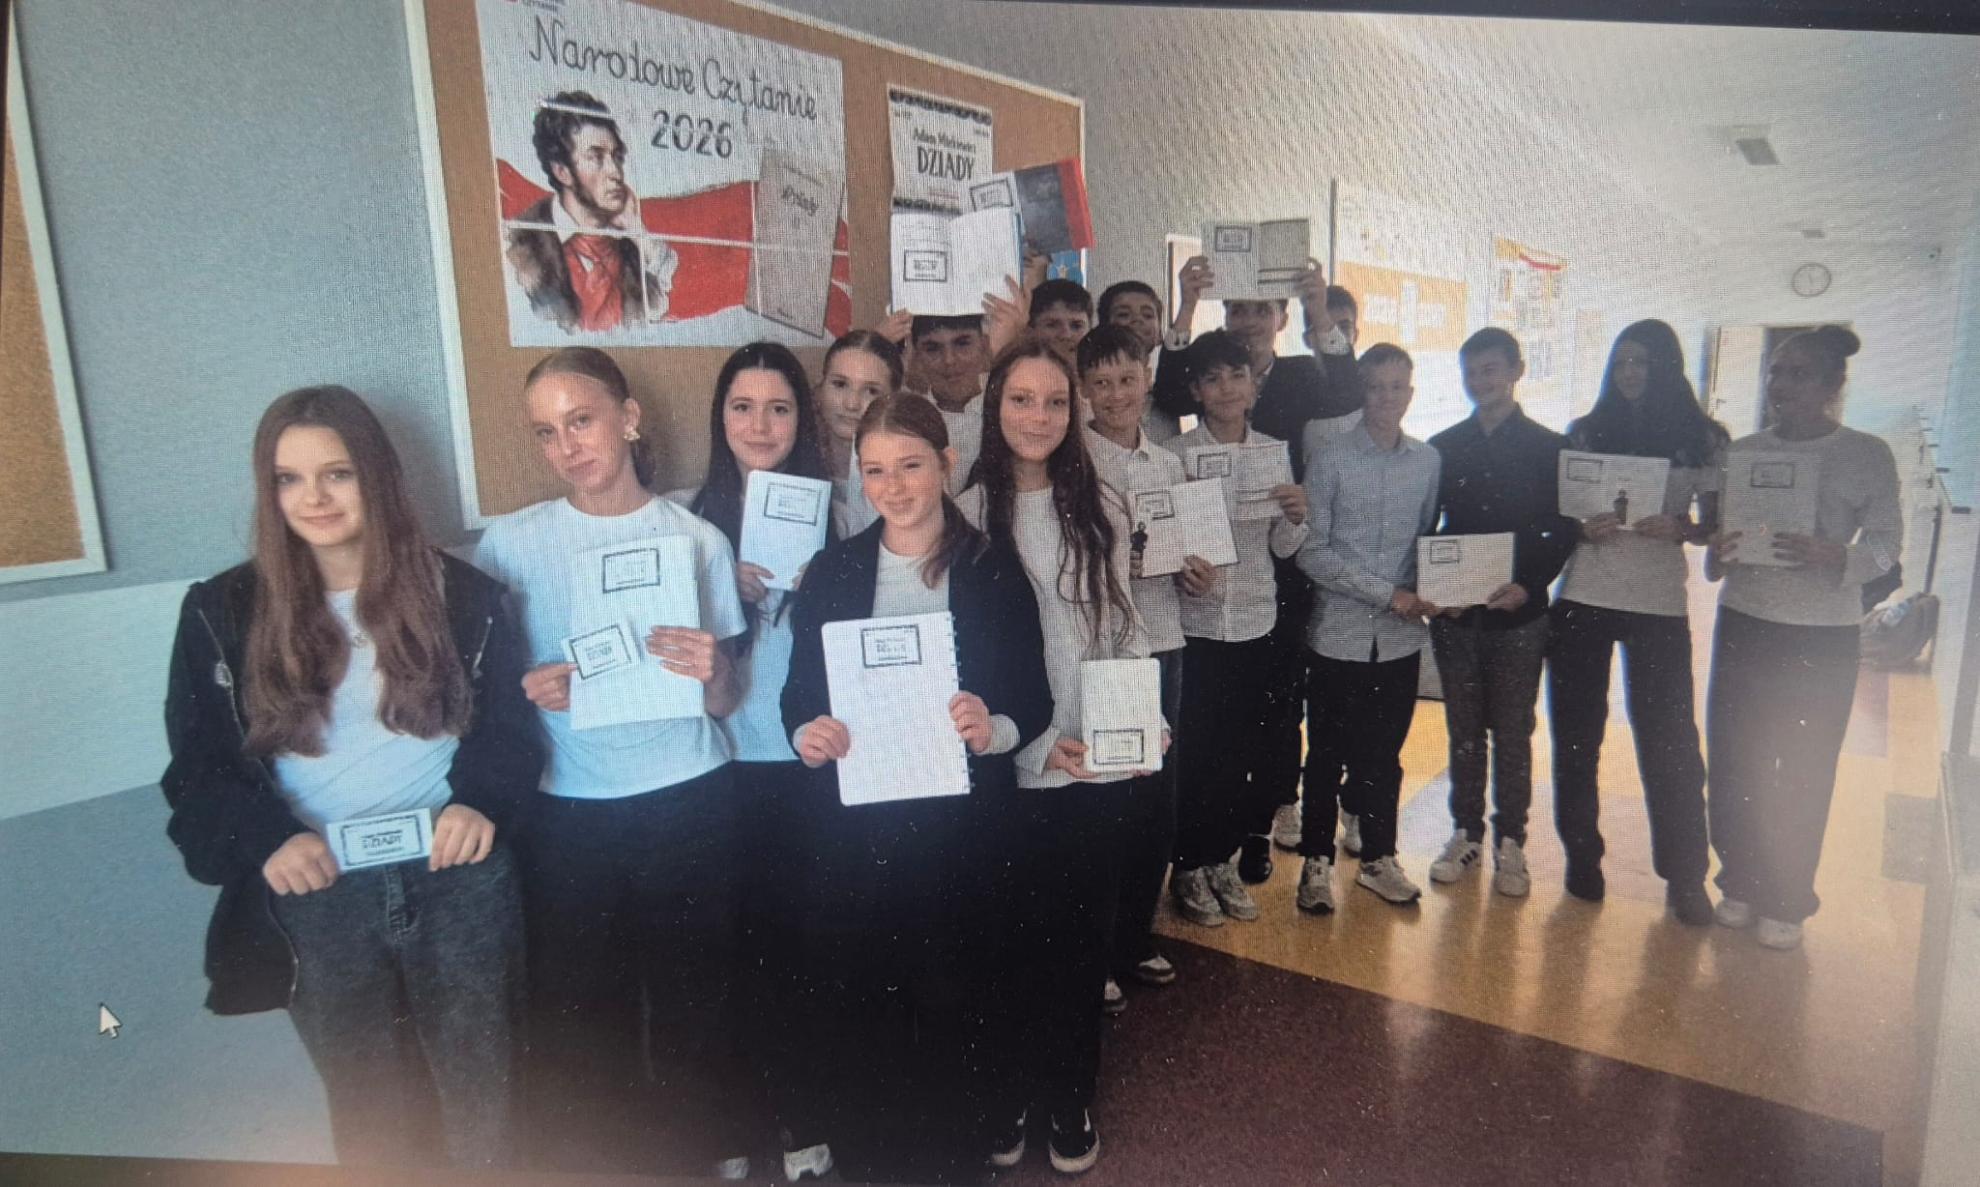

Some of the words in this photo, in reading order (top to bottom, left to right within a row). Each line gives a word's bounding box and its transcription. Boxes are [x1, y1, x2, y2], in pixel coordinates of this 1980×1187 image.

[528, 14, 696, 95] Narodowe
[703, 58, 818, 127] Czytanie
[650, 109, 734, 159] 2026
[916, 145, 977, 182] DZIADY
